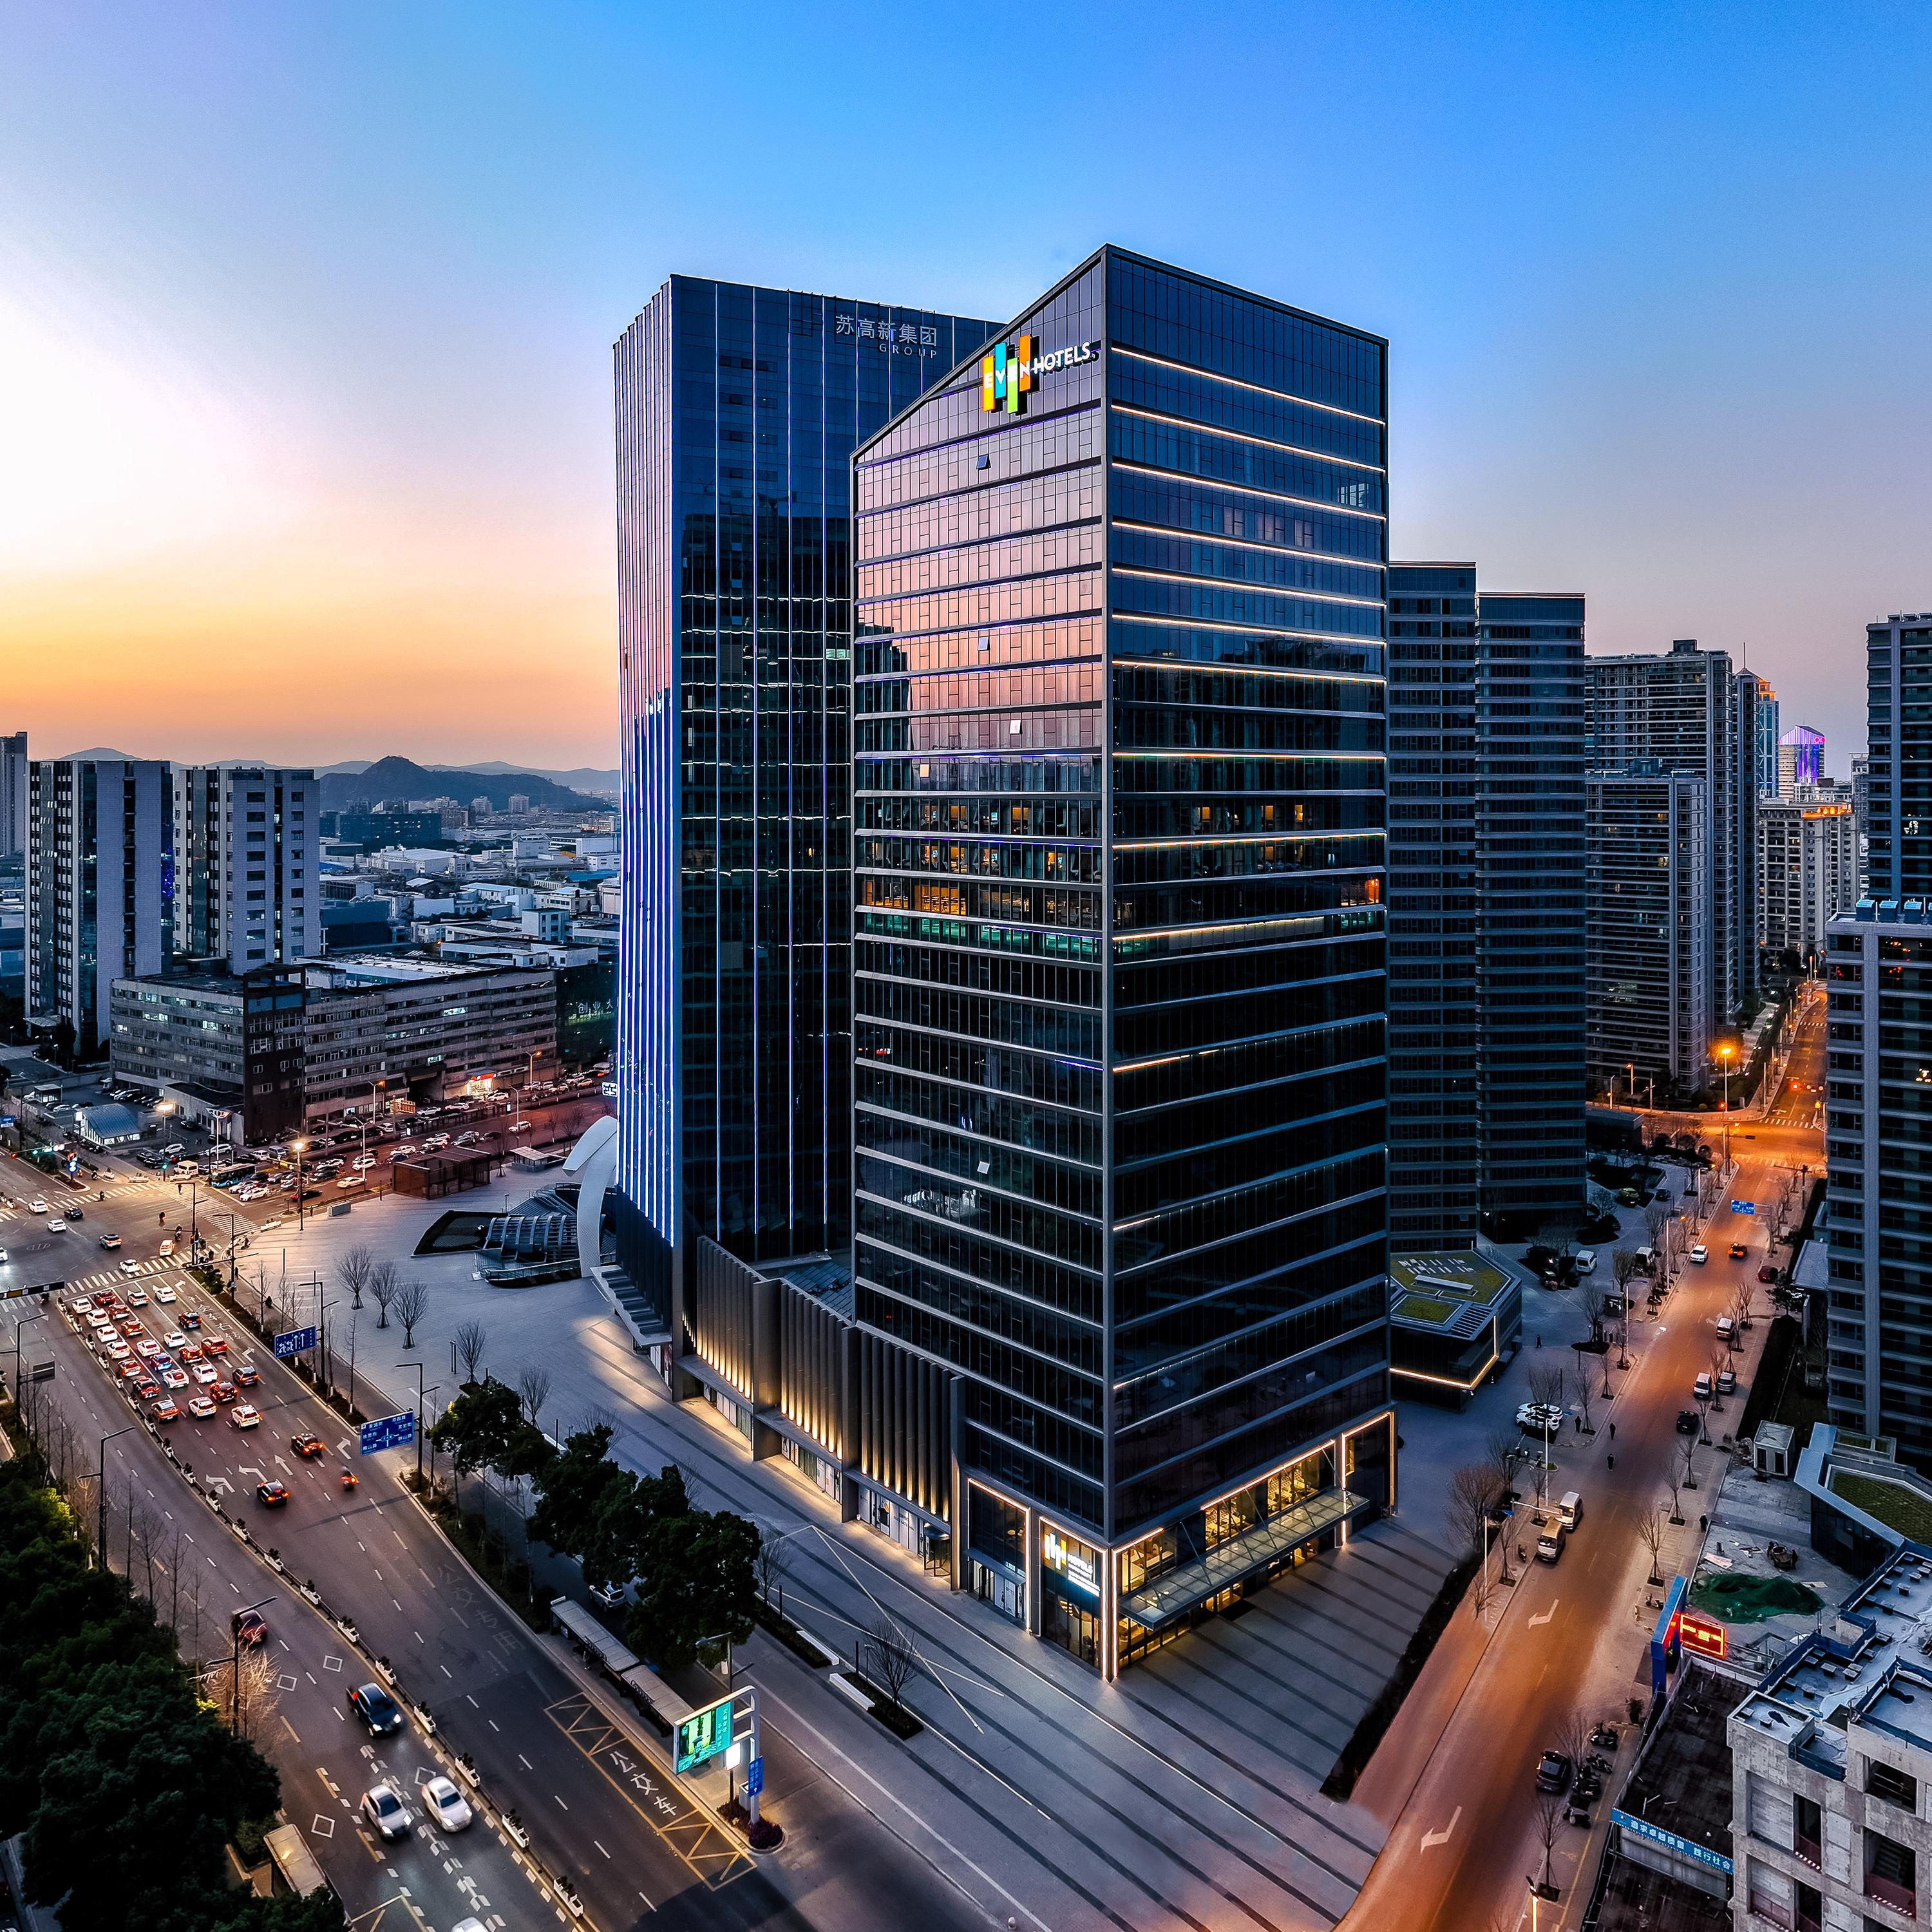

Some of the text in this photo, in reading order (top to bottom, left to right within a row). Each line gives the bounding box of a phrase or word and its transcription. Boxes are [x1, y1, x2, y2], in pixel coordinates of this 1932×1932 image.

[835, 314, 937, 346] 苏高新集团
[880, 343, 937, 359] GROUP
[1031, 341, 1091, 374] HOTELS
[578, 998, 619, 1014] 创业大
[437, 1564, 526, 1656] 公交专用
[609, 1750, 677, 1816] 公交车
